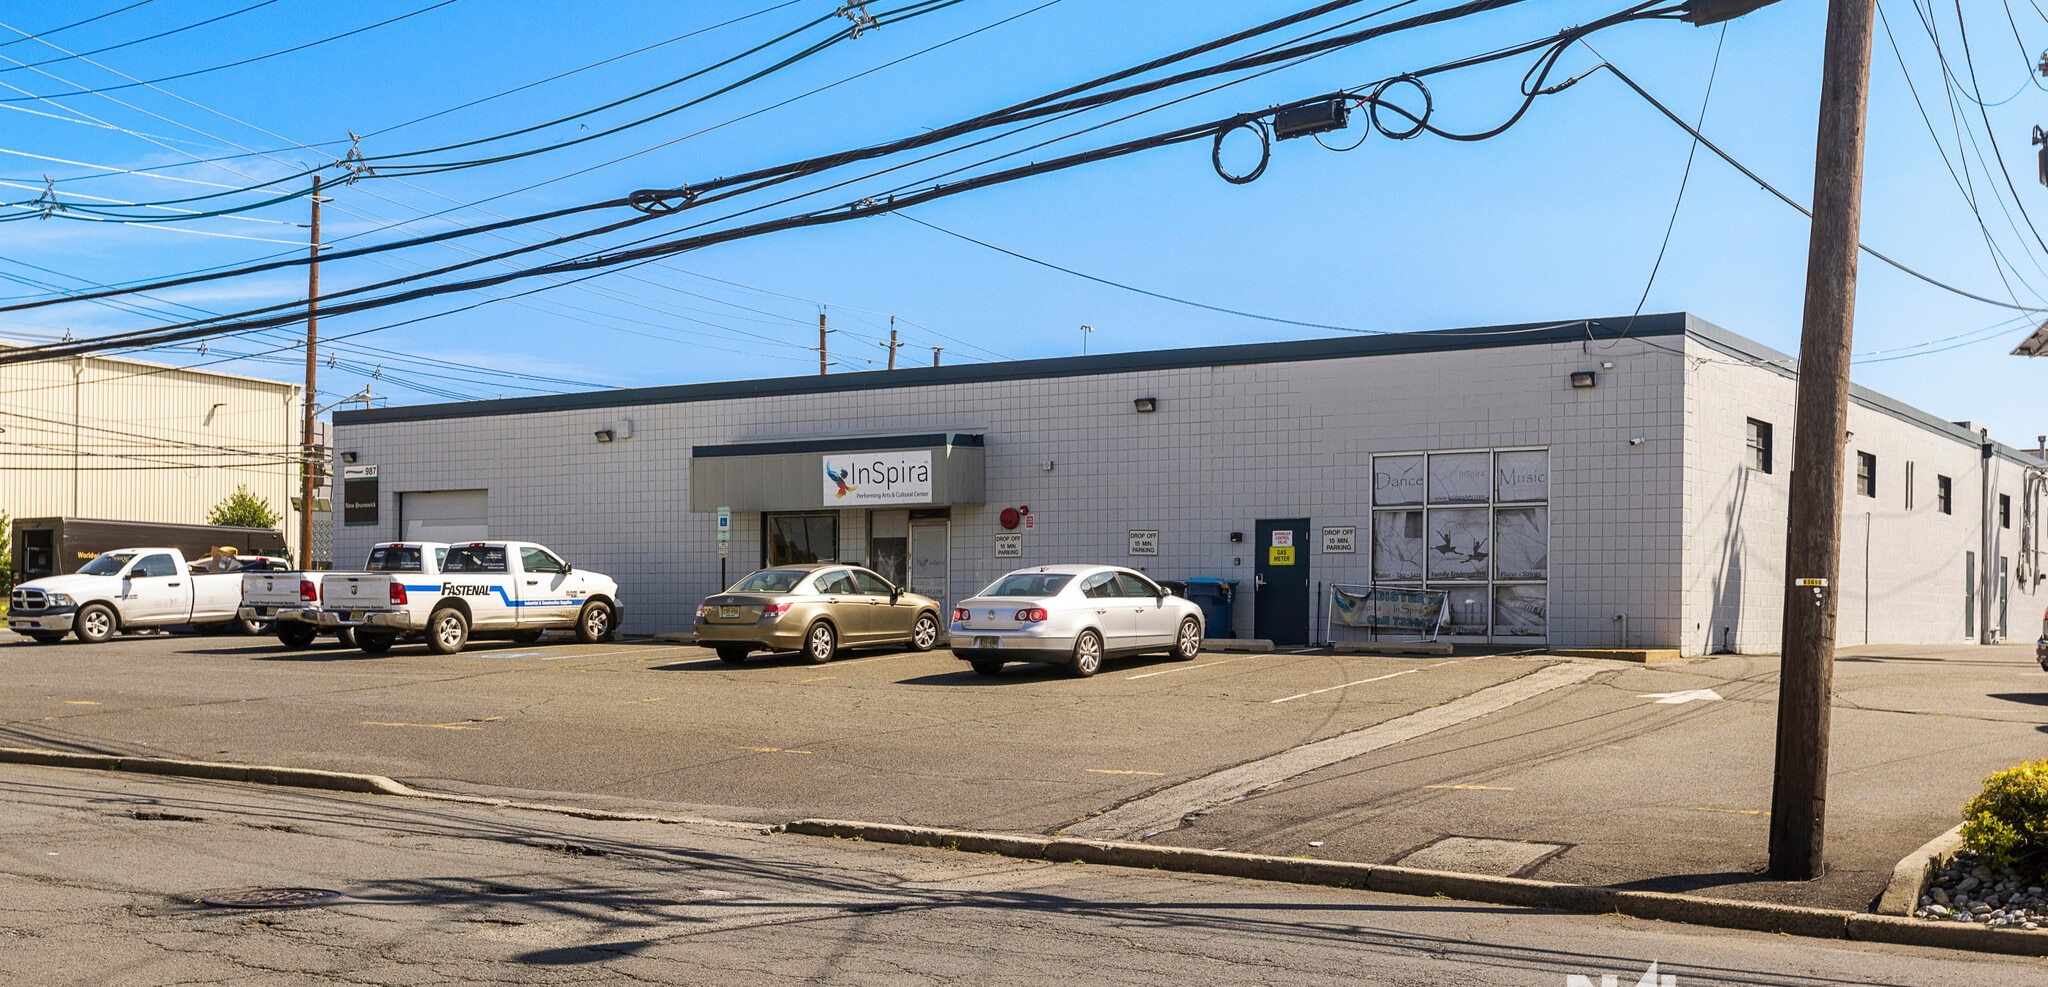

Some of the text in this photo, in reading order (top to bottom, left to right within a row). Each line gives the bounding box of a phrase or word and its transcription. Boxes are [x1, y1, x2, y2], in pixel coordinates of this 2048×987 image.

[365, 467, 376, 475] 987
[852, 460, 928, 490] InSpira
[1500, 469, 1545, 486] Music
[1376, 472, 1424, 490] Dance
[77, 551, 102, 559] Worldwi
[441, 582, 491, 596] FASTENAL
[1360, 590, 1425, 603] EGISTER
